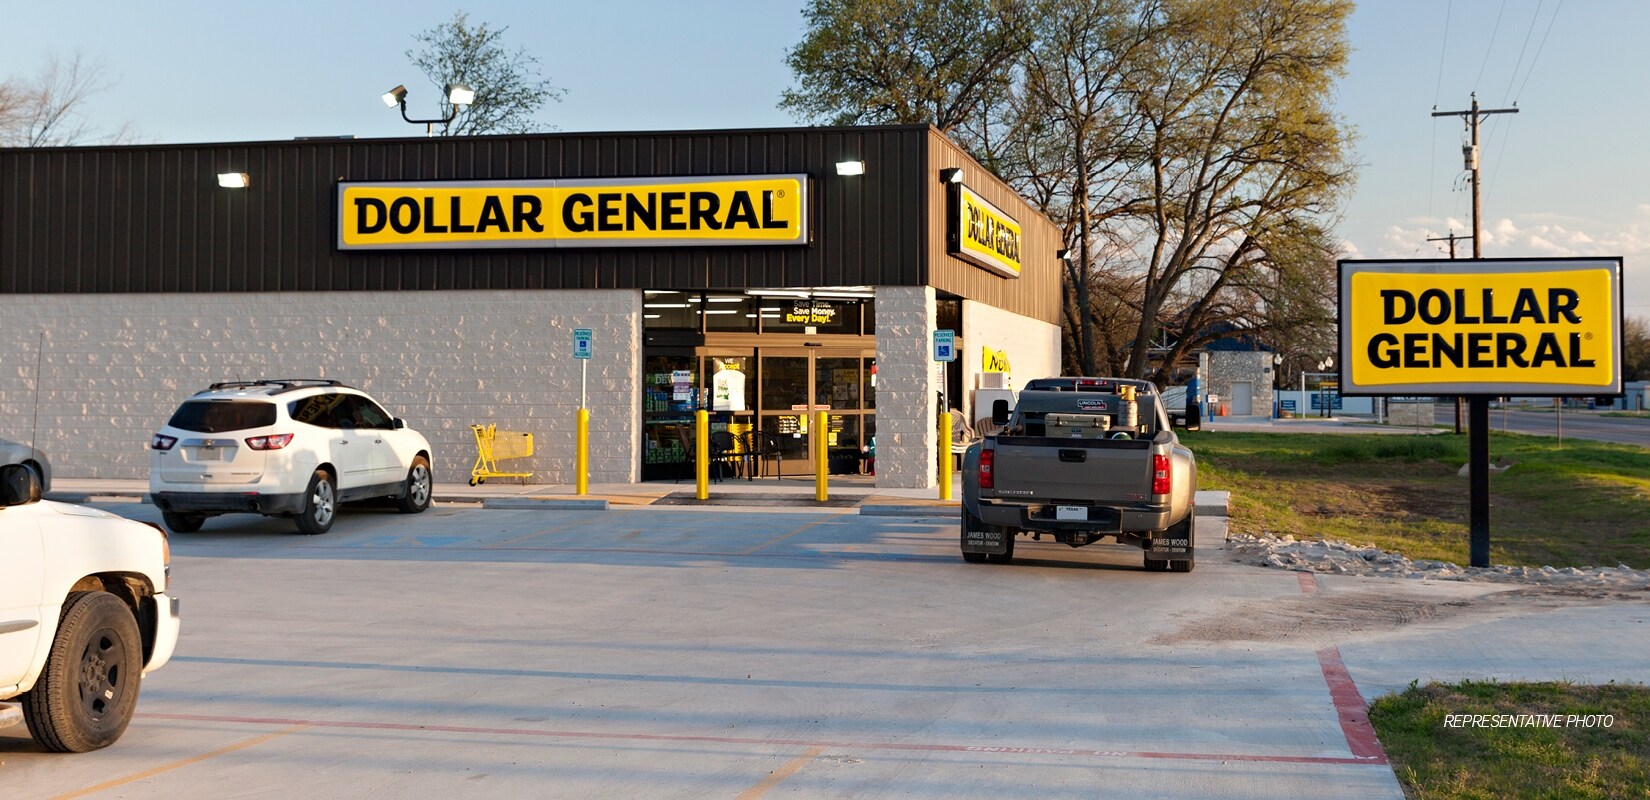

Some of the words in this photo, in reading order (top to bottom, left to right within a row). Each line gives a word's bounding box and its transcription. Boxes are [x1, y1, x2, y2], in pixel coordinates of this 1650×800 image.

[355, 194, 543, 234] DOLLAR
[967, 202, 995, 251] DOLLAR
[996, 220, 1020, 264] GENERAL
[787, 313, 810, 323] Every
[1381, 288, 1582, 325] DOLLAR
[967, 531, 984, 539] JAMES
[1153, 538, 1169, 546] JAMES
